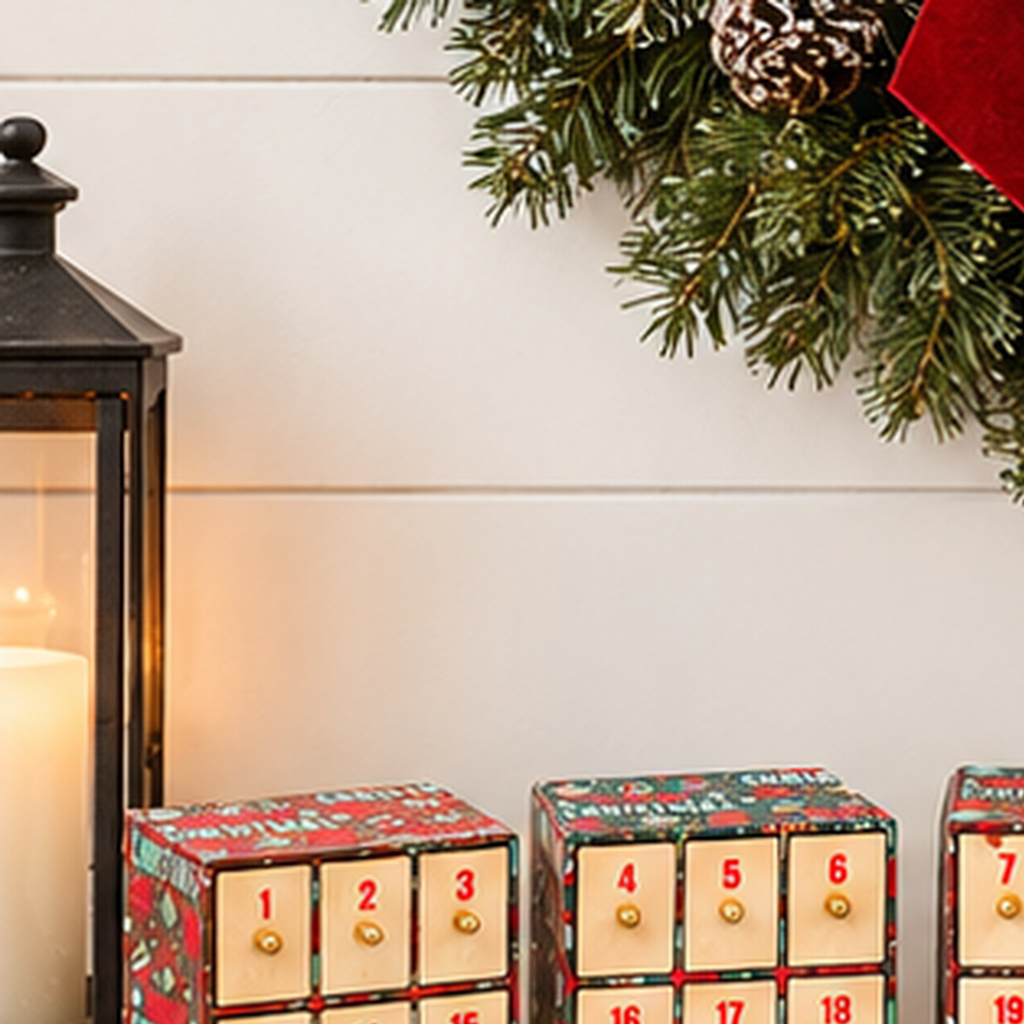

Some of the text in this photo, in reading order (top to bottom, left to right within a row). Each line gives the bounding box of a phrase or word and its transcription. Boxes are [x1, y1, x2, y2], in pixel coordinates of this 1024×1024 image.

[617, 863, 637, 894] 4
[722, 858, 742, 890] 5
[828, 853, 848, 885] 6
[998, 852, 1017, 885] 7
[358, 879, 377, 911] 2
[455, 868, 475, 902] 3
[258, 888, 272, 921] 1
